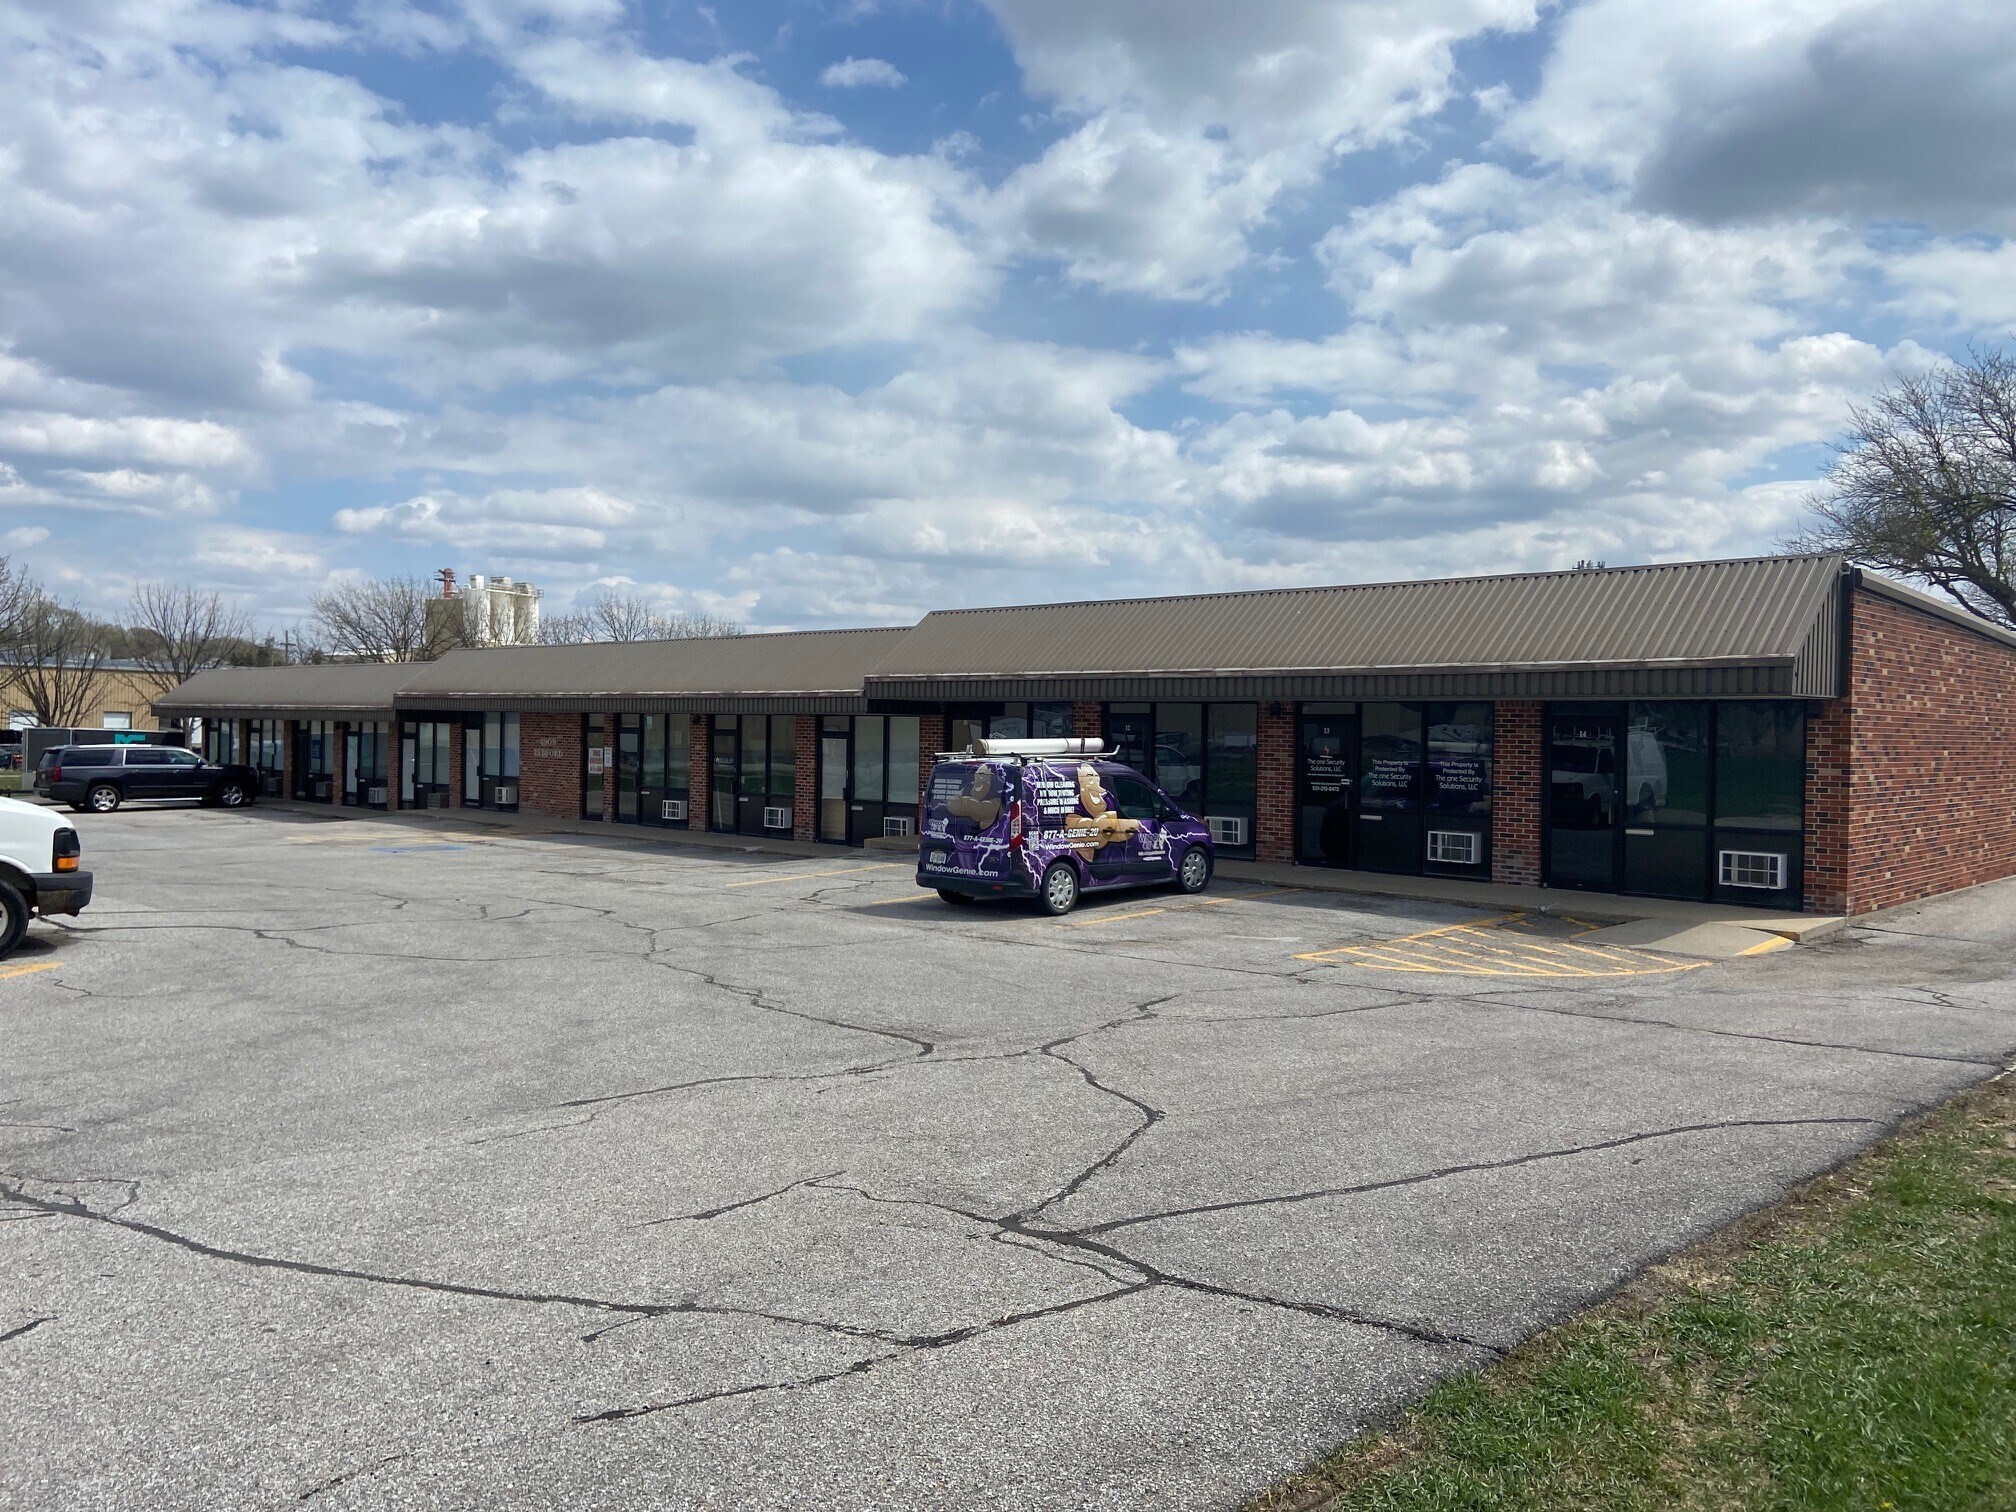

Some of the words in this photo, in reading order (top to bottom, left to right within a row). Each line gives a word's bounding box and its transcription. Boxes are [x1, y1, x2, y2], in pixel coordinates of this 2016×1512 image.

[1579, 730, 1587, 738] 14
[1326, 759, 1345, 767] Security
[1310, 765, 1333, 773] Solutions,
[1390, 773, 1412, 781] Security
[1459, 776, 1482, 784] Security
[1372, 779, 1397, 788] Solutions,
[1439, 782, 1467, 791] Solutions,
[1468, 783, 1479, 791] LLC
[1037, 798, 1059, 806] PRESSURE
[1043, 828, 1099, 840] 877-A-GENIE-2U
[1044, 842, 1100, 851] WindowGenie.com
[925, 863, 999, 877] WindowGenie.com
